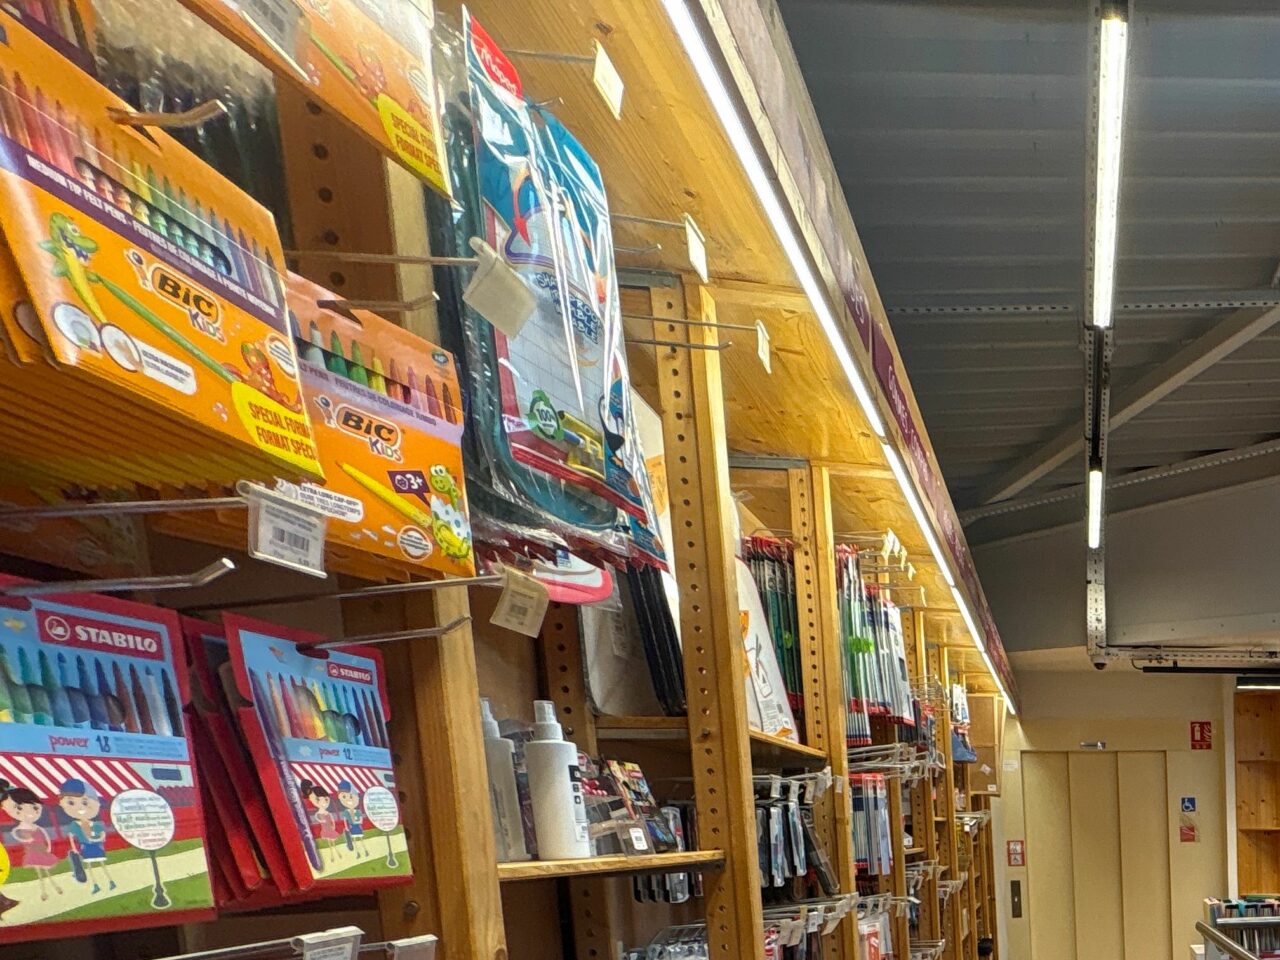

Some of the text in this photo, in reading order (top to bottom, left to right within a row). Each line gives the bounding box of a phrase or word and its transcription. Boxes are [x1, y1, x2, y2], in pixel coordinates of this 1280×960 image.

[75, 625, 158, 653] STABILO
[340, 667, 371, 682] STABILO
[49, 735, 89, 752] power
